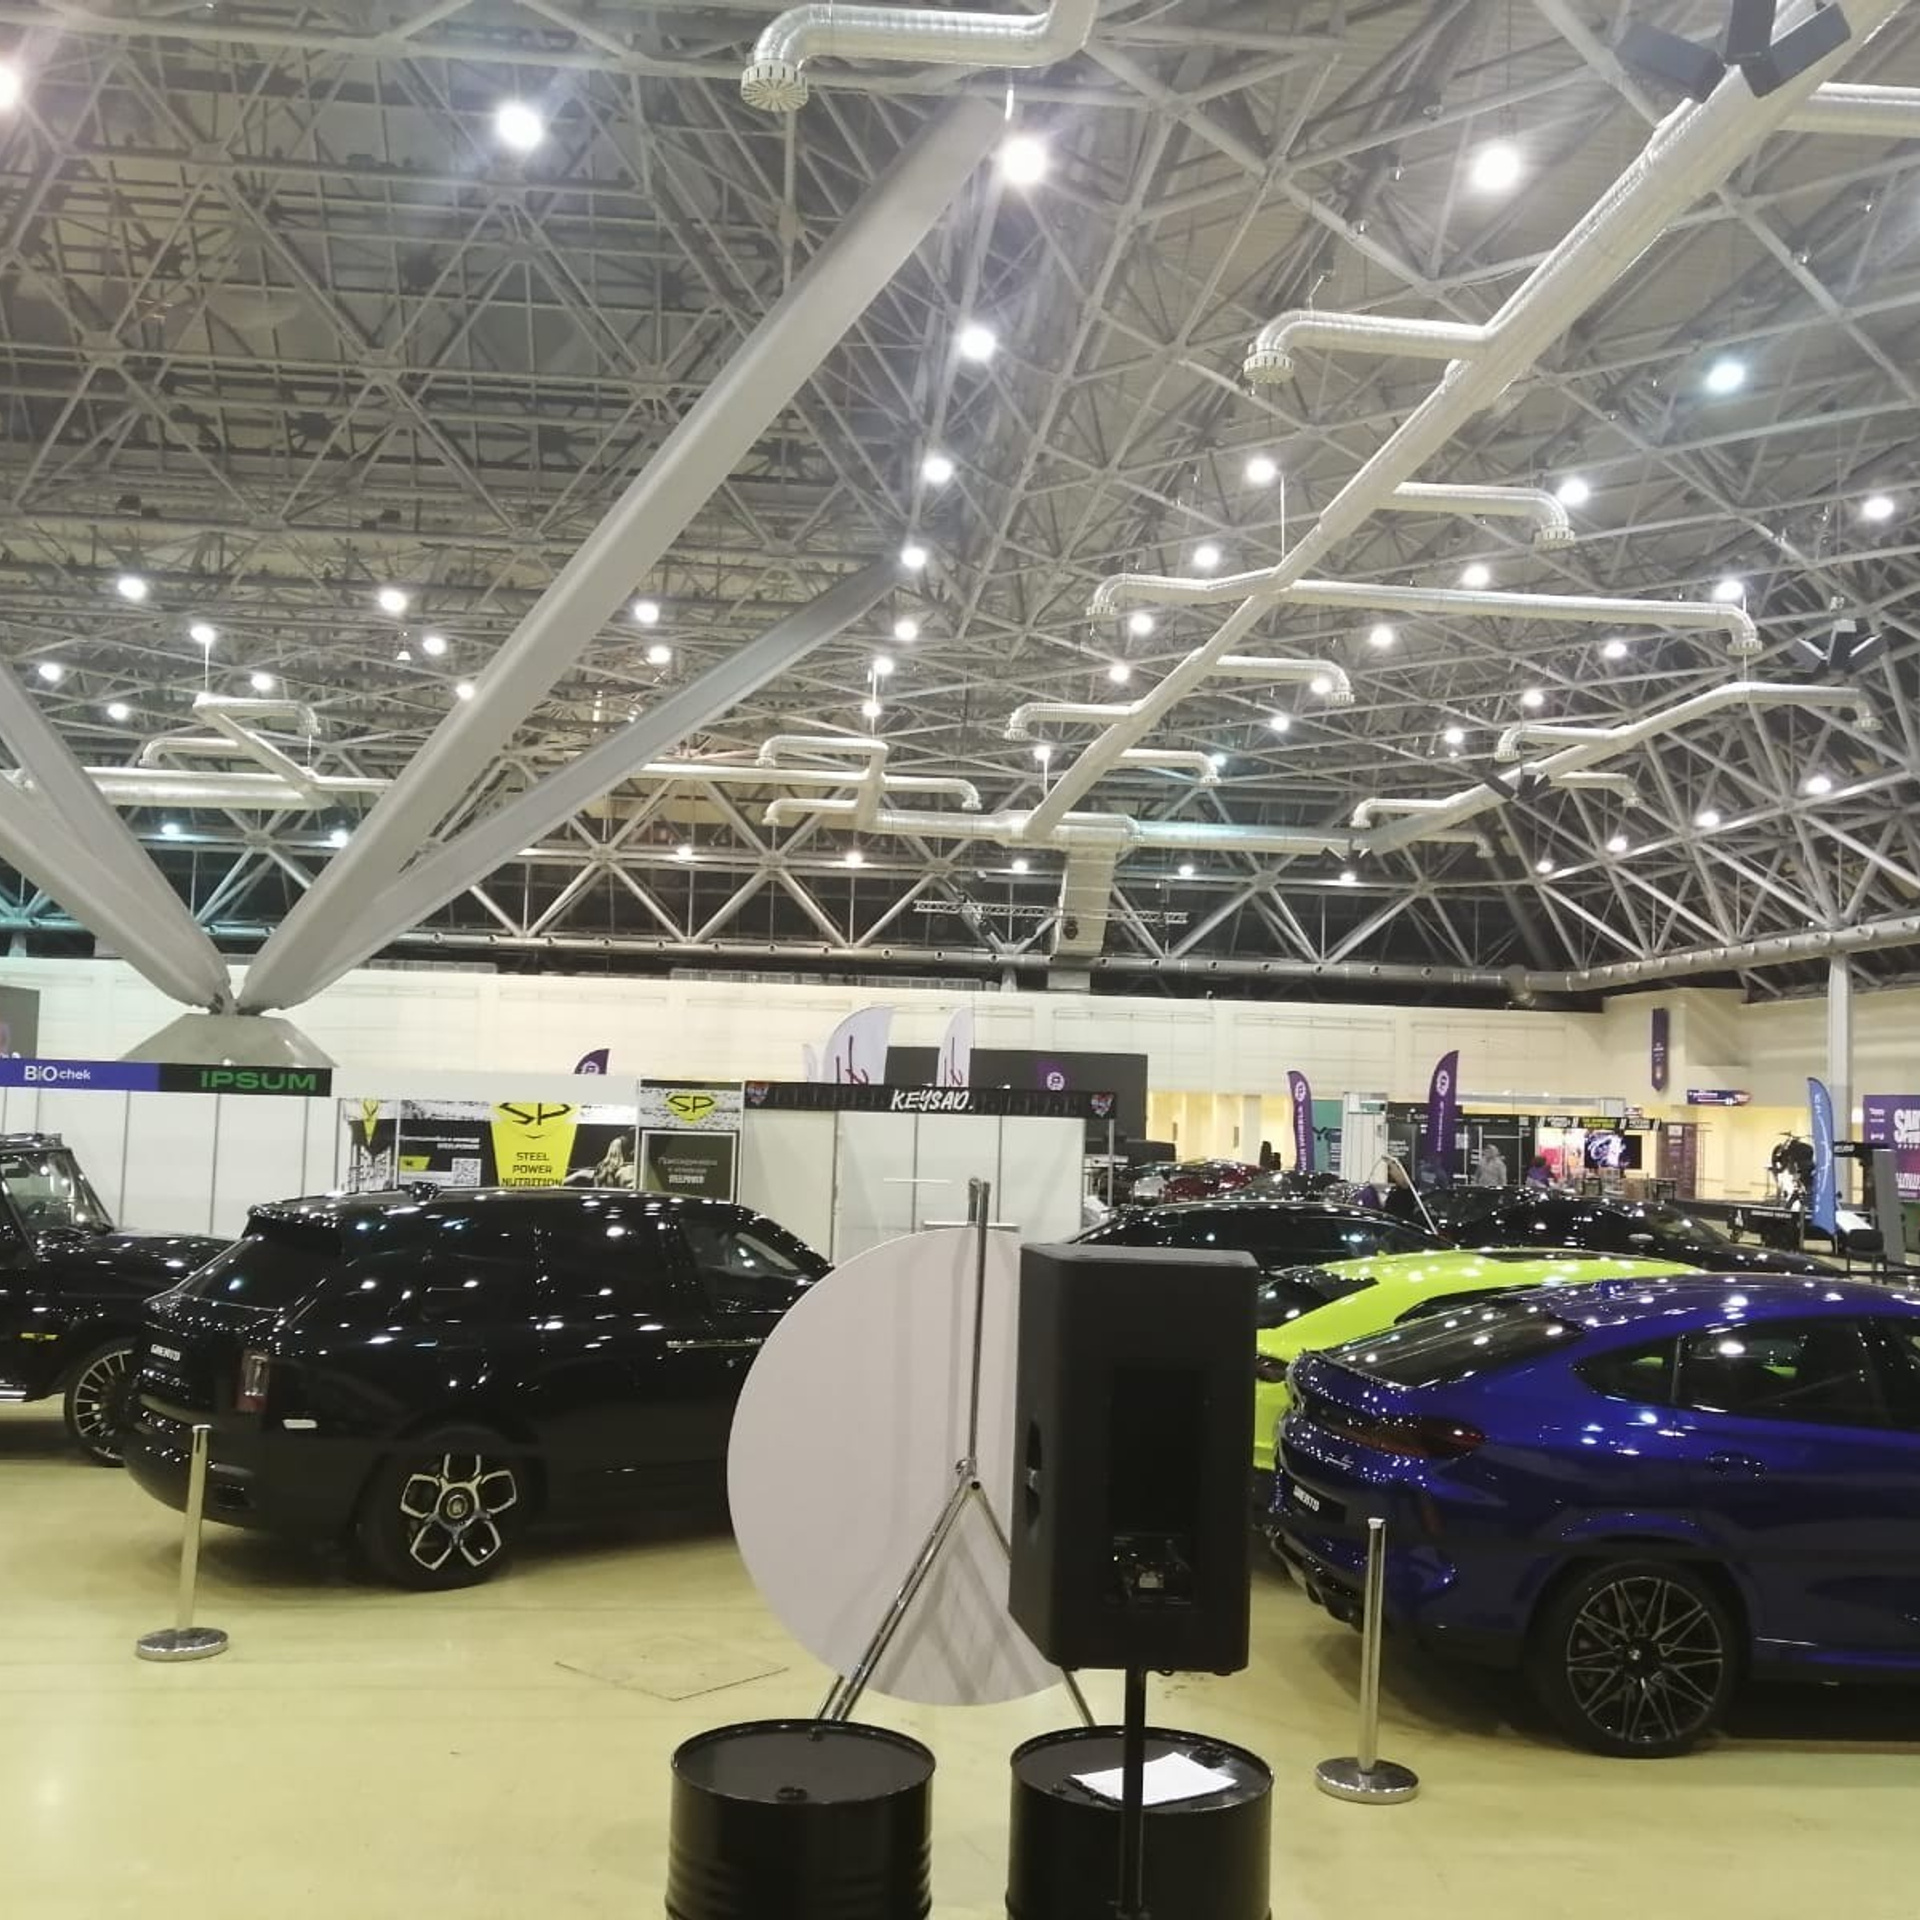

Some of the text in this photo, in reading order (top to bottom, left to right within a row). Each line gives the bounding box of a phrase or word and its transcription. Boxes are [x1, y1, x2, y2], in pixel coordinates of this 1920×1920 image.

[200, 1070, 317, 1091] IPSUM
[516, 1152, 550, 1161] STEEL
[512, 1164, 553, 1174] POWER
[501, 1177, 563, 1187] NUTRITION
